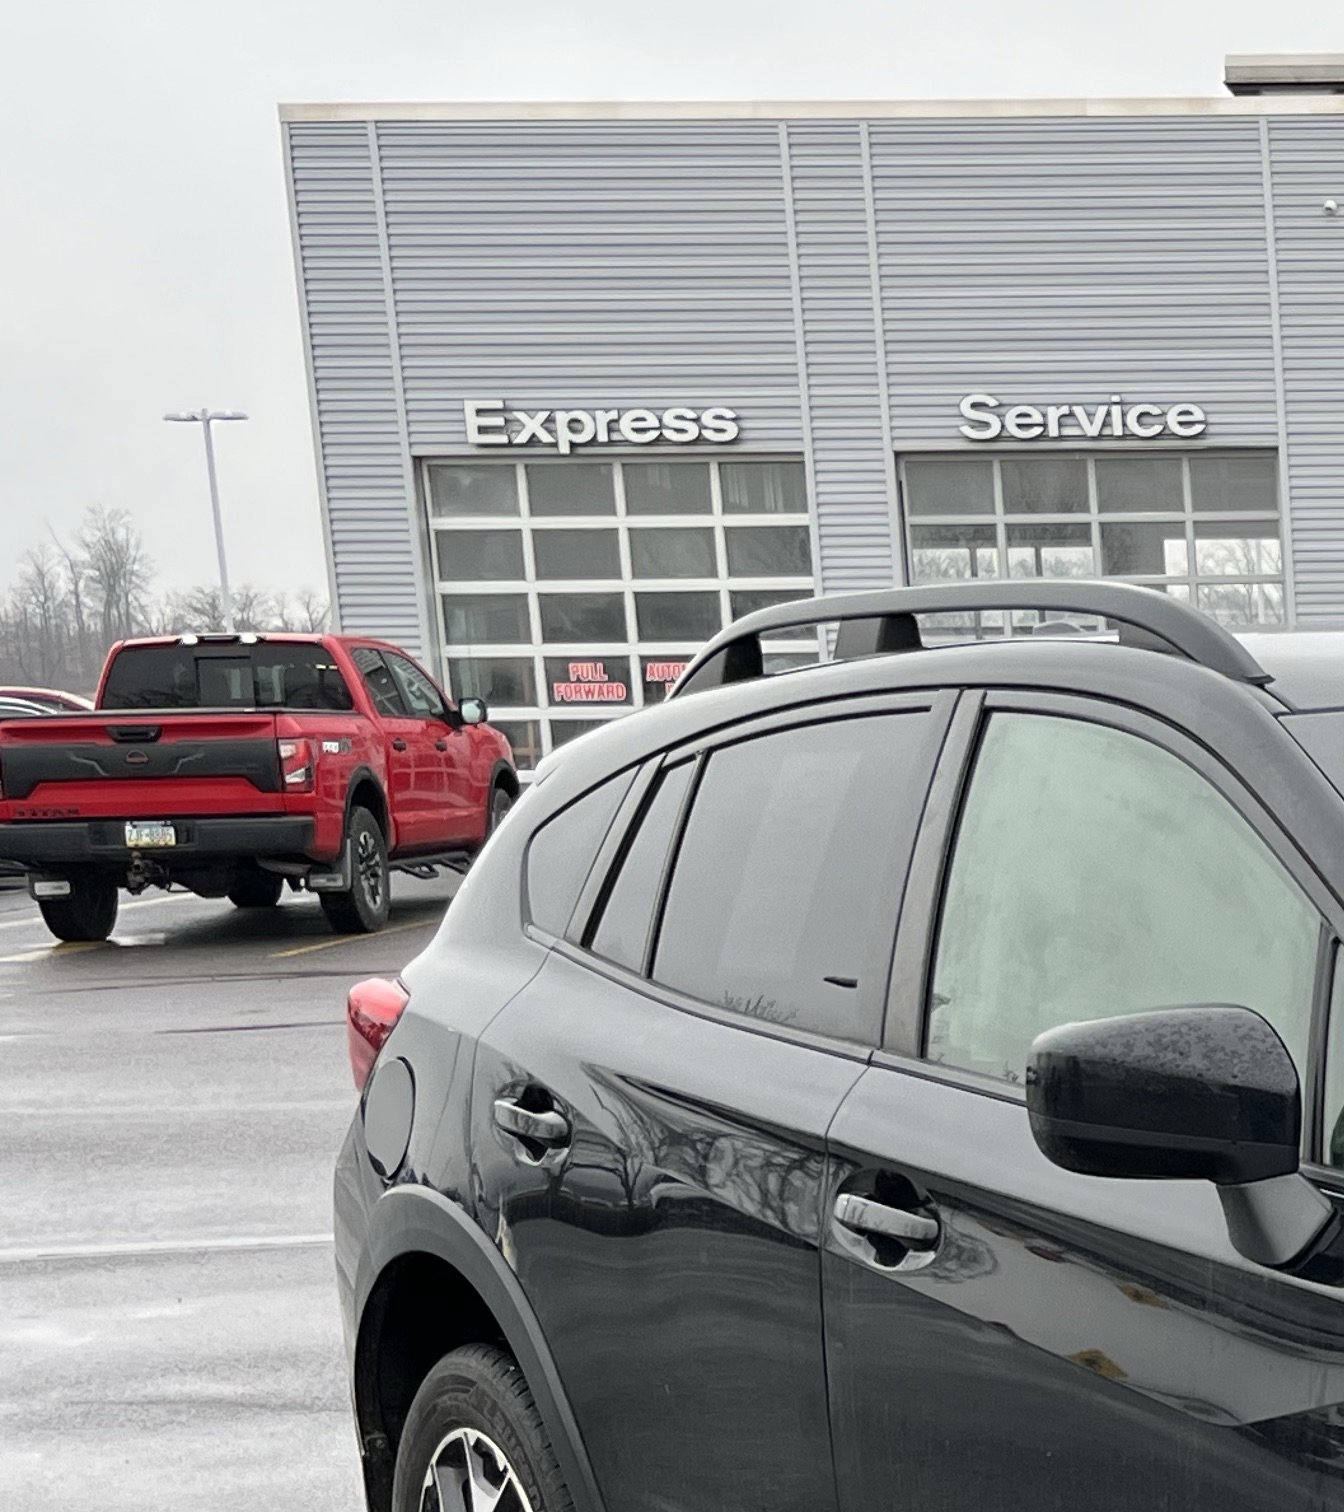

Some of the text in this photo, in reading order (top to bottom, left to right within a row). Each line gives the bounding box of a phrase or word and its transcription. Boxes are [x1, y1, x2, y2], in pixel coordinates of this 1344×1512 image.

[463, 399, 741, 454] Express
[958, 393, 1207, 441] Service
[568, 661, 608, 682] PULL
[553, 682, 627, 702] FORWARD
